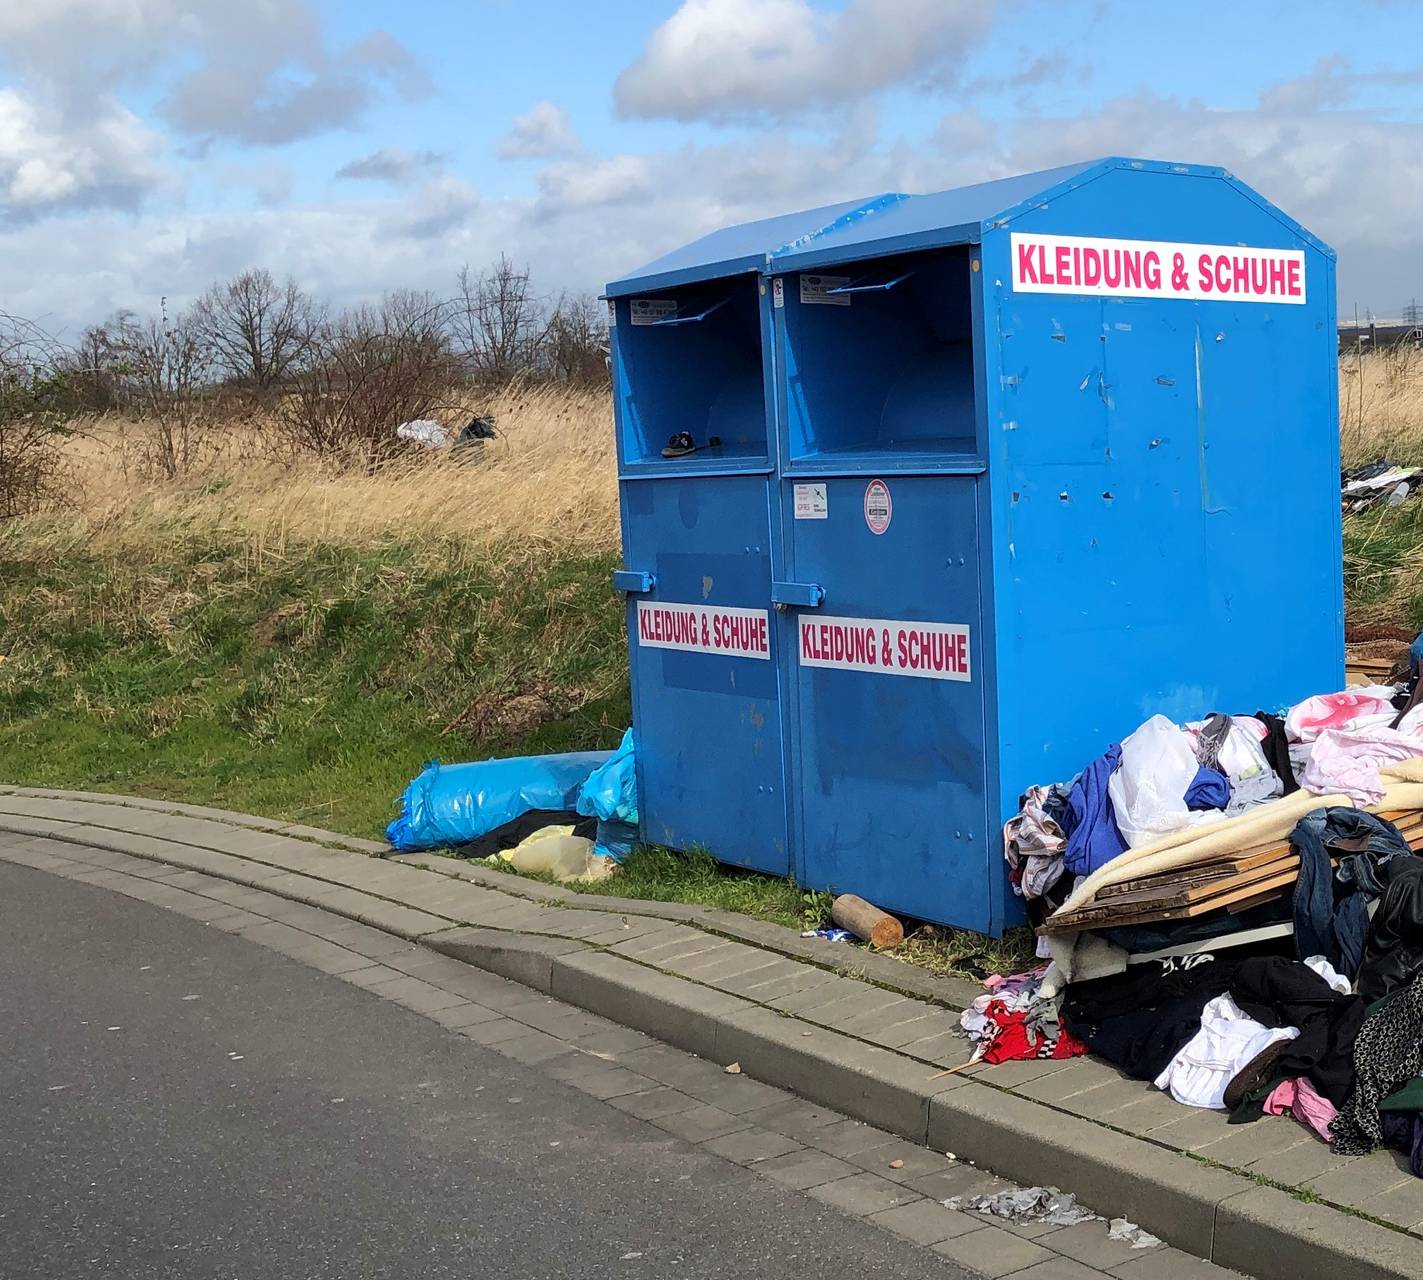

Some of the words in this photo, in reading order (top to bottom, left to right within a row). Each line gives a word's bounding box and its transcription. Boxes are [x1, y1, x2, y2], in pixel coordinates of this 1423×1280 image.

[1017, 243, 1162, 290] KLEIDUNG
[1170, 251, 1190, 291] &
[1198, 253, 1302, 297] SCHUHE
[639, 608, 698, 644] KLEIDUNG
[701, 617, 711, 647] &
[713, 615, 768, 652] SCHUHE
[801, 623, 877, 665] KLEIDUNG
[882, 629, 893, 667] &
[898, 629, 968, 673] SCHUHE
